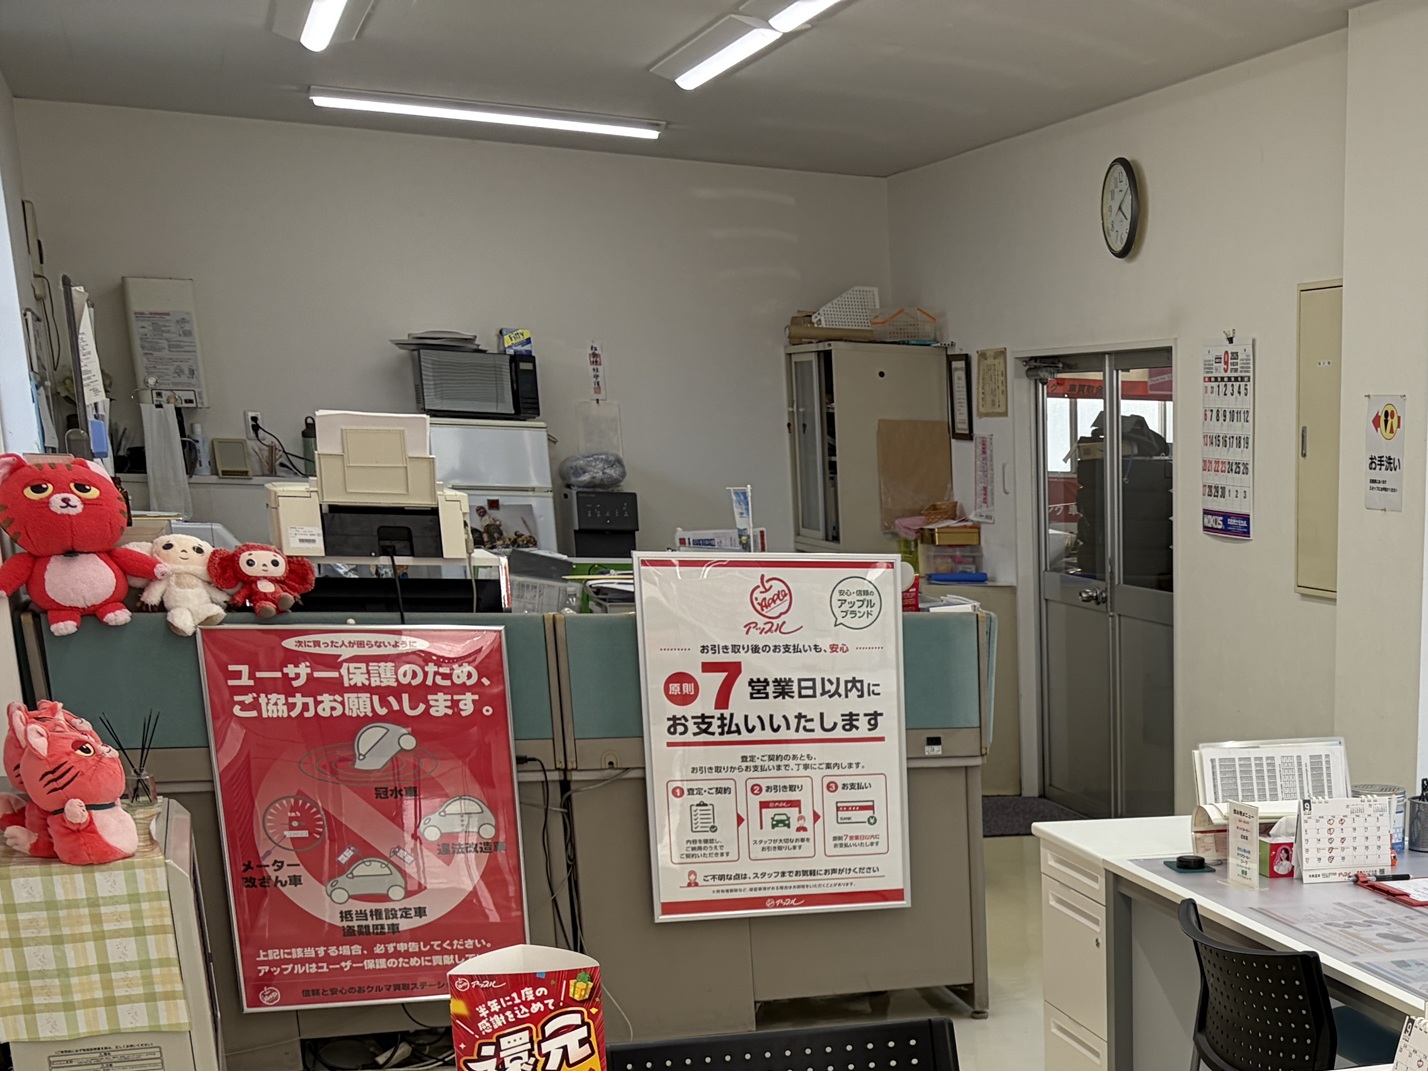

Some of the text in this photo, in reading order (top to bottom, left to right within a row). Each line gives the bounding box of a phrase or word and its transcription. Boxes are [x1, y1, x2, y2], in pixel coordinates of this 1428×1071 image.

[1224, 350, 1229, 373] 9
[1218, 384, 1248, 396] 1 2 3 4 5
[1369, 455, 1401, 472] お手洗い
[838, 589, 874, 597] 安心・信頼の
[837, 599, 875, 609] アップル
[840, 609, 874, 619] ブランド
[743, 621, 803, 635] アップル
[294, 638, 418, 650] 次に買った人が困らないように
[699, 643, 849, 655] お引き取り後のお支払いも、安心
[227, 662, 492, 688] ユーザー保護のため、
[669, 683, 695, 695] 原則
[700, 661, 881, 710] 7 営業日以内に
[232, 692, 494, 718] ご協力お願いします。
[666, 711, 884, 737] お支払いいたします
[375, 786, 419, 799] 冠水車
[686, 786, 732, 796] 査定・ご契約
[765, 784, 803, 793] お引き取り
[841, 782, 872, 790] お支払い
[436, 841, 506, 855] 違法改造車
[679, 851, 730, 859] ご契約いただきます
[761, 844, 802, 852] お引き取りします
[242, 860, 300, 873] メーター
[703, 866, 879, 882] ご不明な点は、スタッフまでお気軽にお声がけください
[242, 875, 303, 889] 改ざん車
[339, 906, 428, 923] 抵当権設定車
[342, 923, 400, 937] 盗難歴車
[256, 938, 492, 961] 上記に該当する場合、必ず申告してください。
[257, 954, 476, 977] アップルはユーザー保護のために貢献し
[475, 986, 548, 1019] 半年に1度の
[478, 999, 556, 1035] 感謝を込めて
